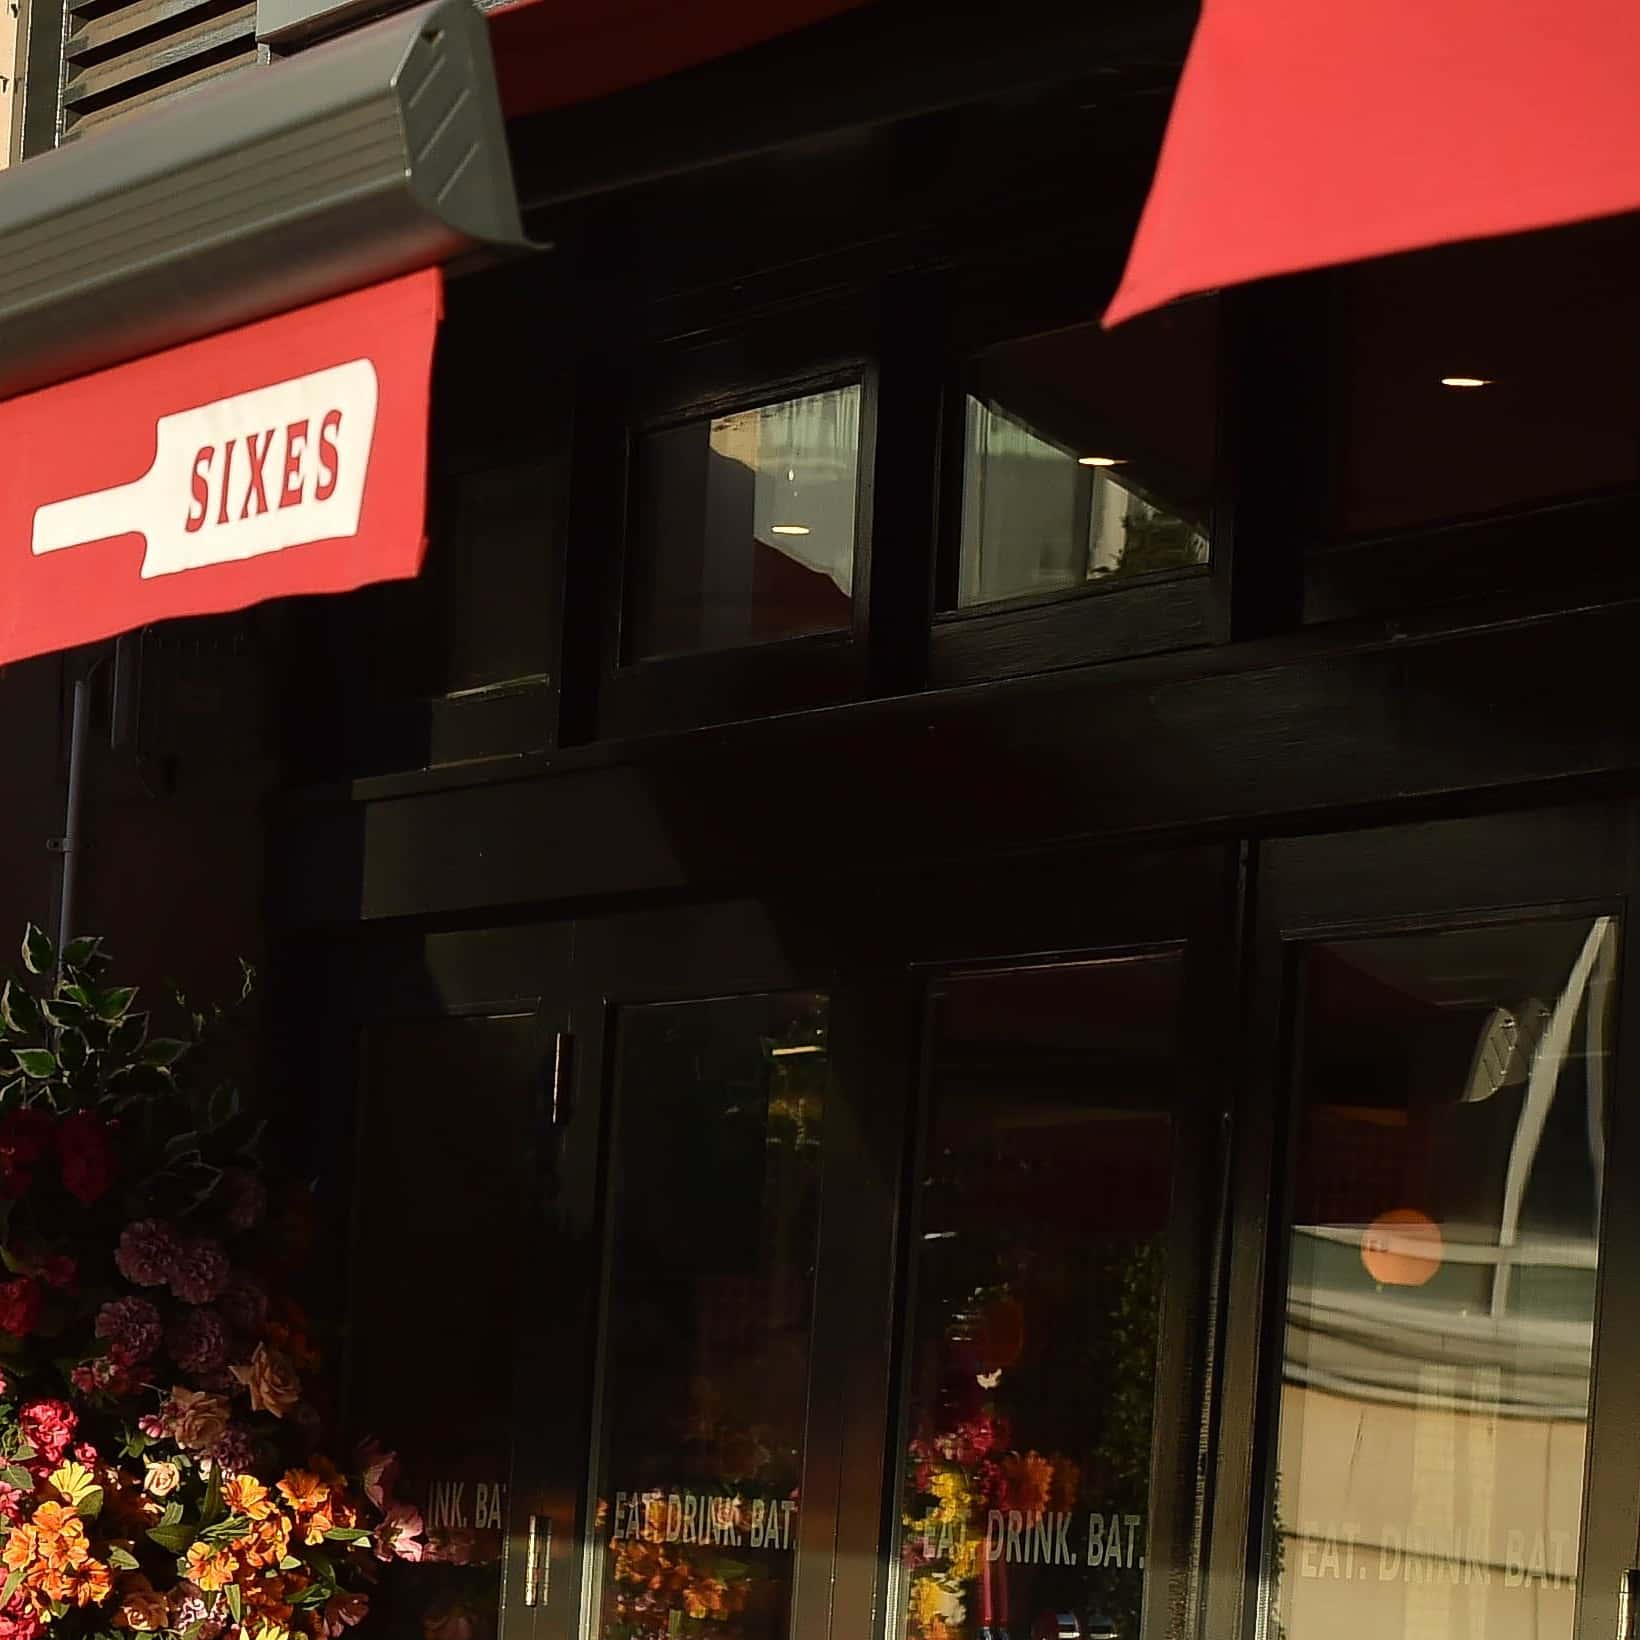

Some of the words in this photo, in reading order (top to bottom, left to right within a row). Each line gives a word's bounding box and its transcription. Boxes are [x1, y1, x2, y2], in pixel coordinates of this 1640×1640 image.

[184, 409, 344, 534] SIXES
[427, 1480, 468, 1529] INK.
[475, 1481, 508, 1529] BA
[666, 1494, 743, 1547] DRINK.
[986, 1508, 1077, 1566] DRINK.
[1087, 1511, 1146, 1569] BAT.
[1300, 1520, 1367, 1579] EAT.
[1378, 1523, 1492, 1585] DRINK.
[1503, 1528, 1578, 1591] BAT.
